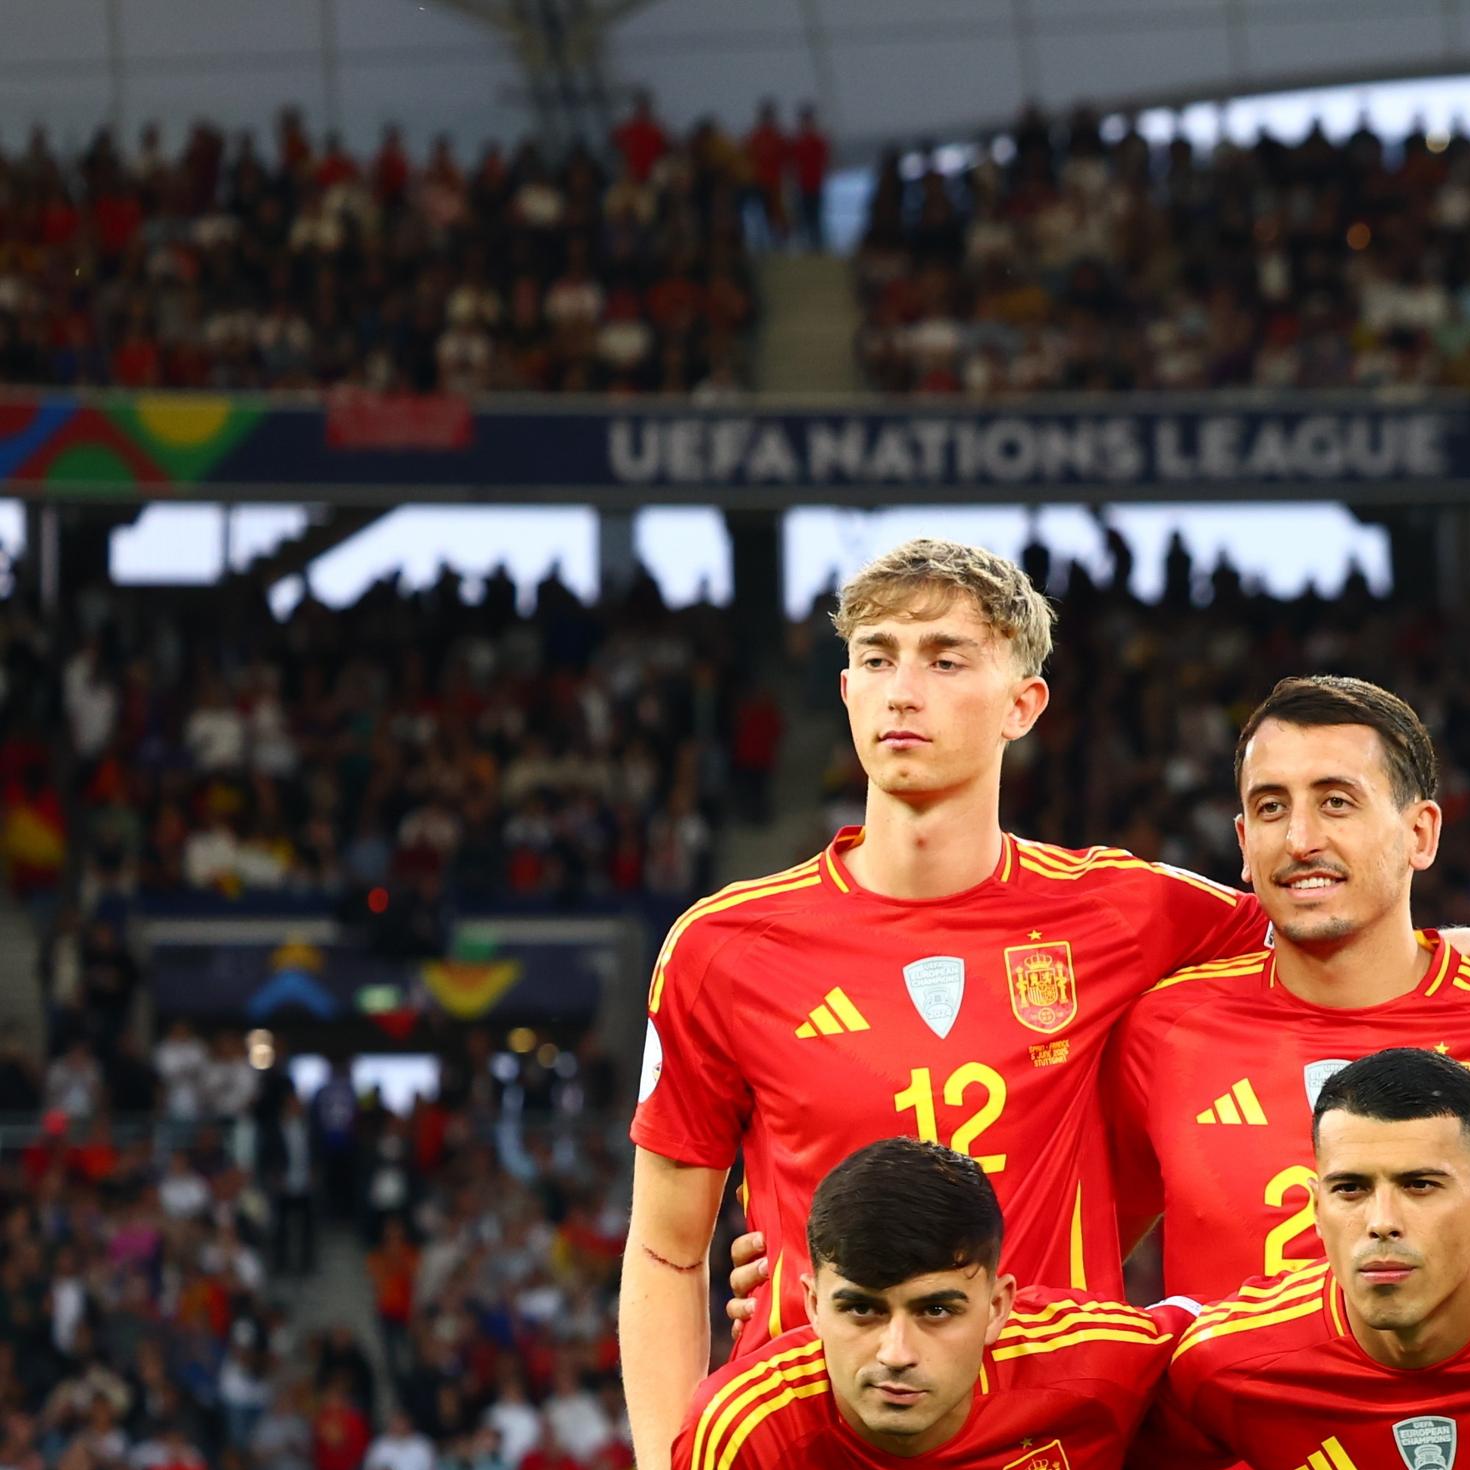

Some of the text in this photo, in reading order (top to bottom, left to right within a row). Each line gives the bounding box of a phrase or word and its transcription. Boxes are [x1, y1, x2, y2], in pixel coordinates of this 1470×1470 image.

[608, 414, 1444, 482] UEFA NATIONS LEAGUE
[894, 1061, 1007, 1174] 12
[1399, 1425, 1450, 1439] EUROPEAN
[1401, 1434, 1452, 1447] CHAMPIONS
